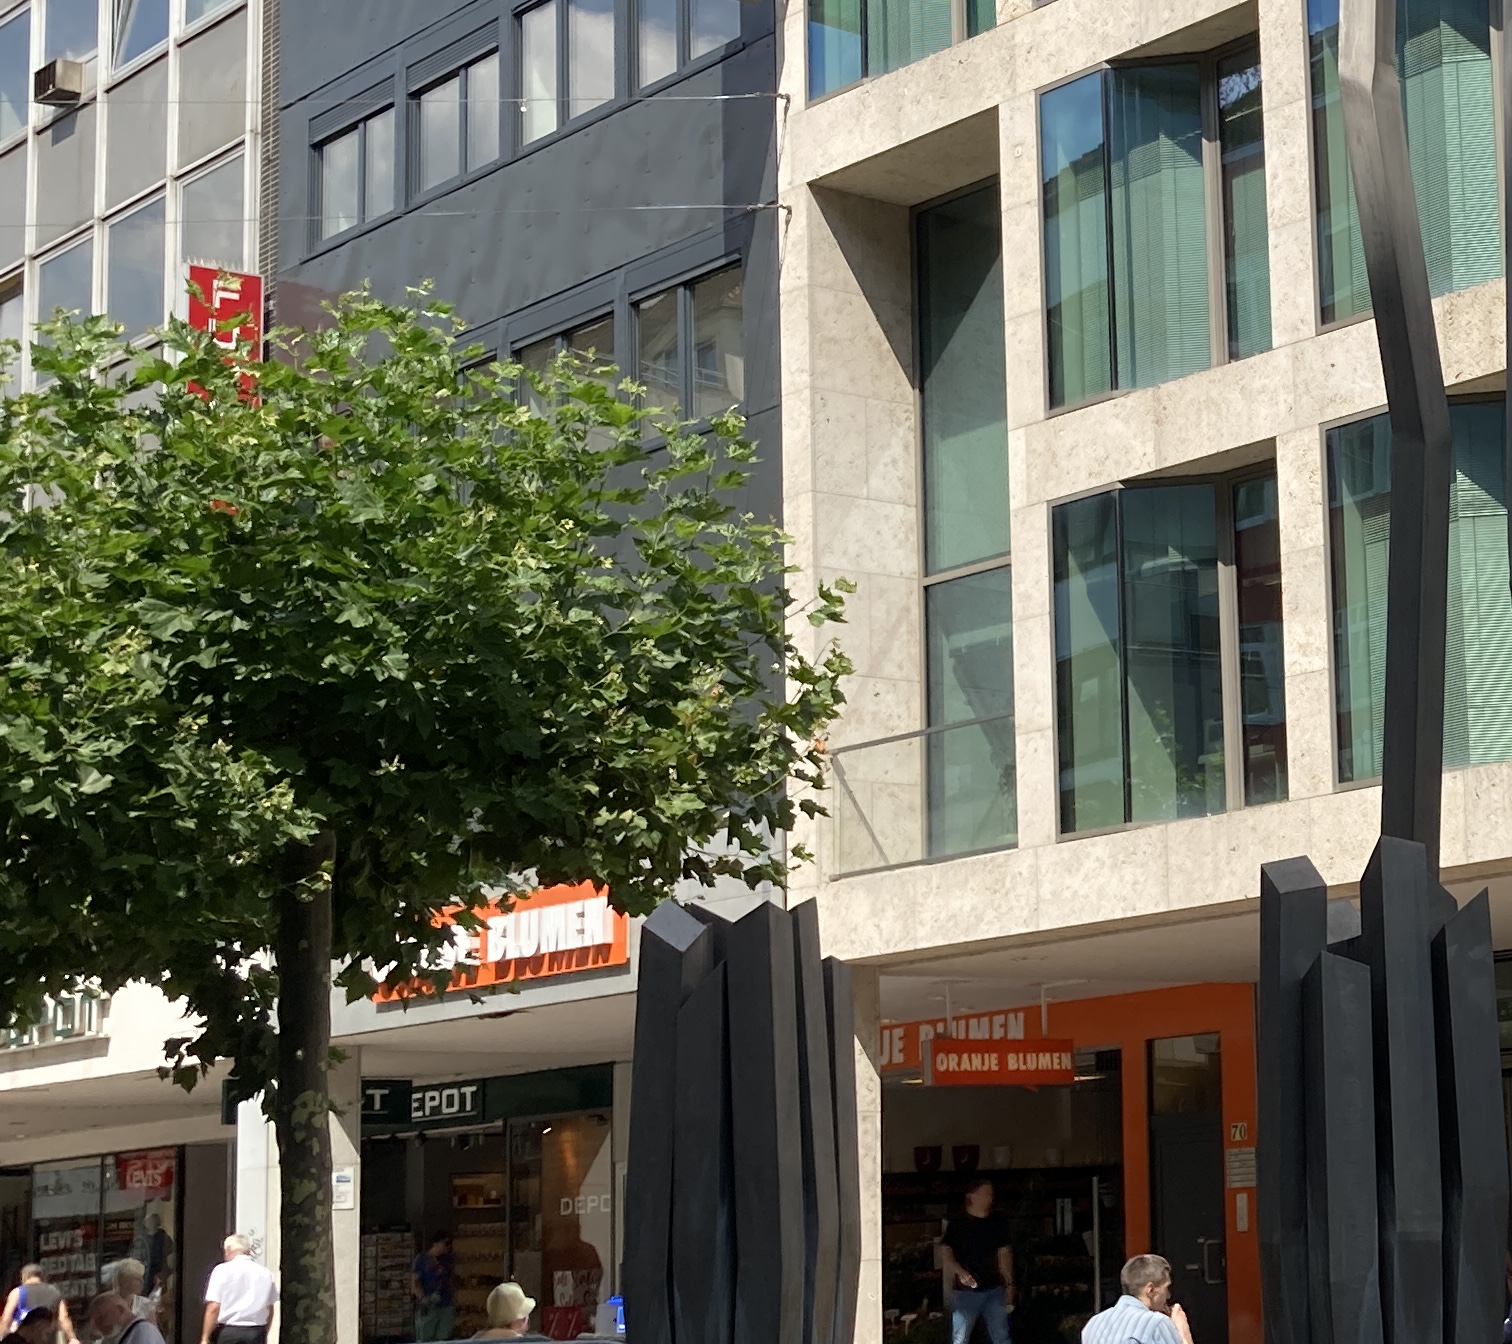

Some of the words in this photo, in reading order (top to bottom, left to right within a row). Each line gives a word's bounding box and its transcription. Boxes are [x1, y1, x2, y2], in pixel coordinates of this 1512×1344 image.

[486, 895, 614, 963] BLUMEN
[935, 1052, 1000, 1072] ORANJE
[1007, 1052, 1072, 1071] BLUMEN
[411, 1085, 478, 1118] EPOT
[1231, 1124, 1247, 1140] 70
[559, 1194, 612, 1216] DEPO
